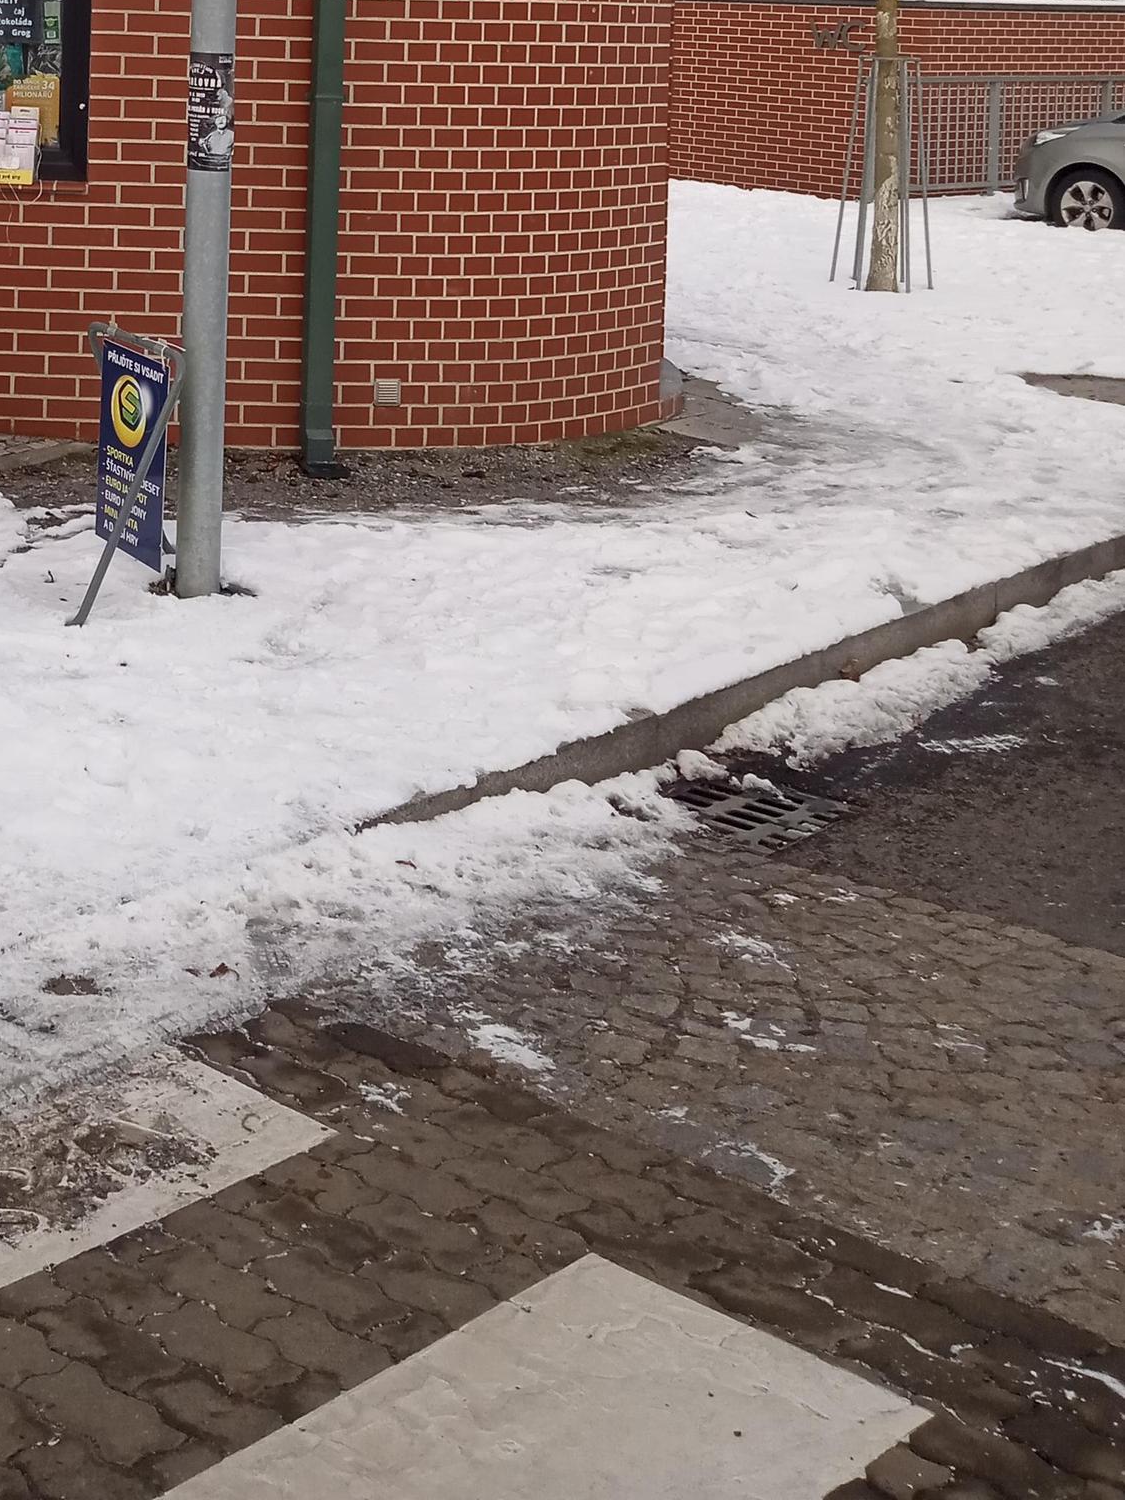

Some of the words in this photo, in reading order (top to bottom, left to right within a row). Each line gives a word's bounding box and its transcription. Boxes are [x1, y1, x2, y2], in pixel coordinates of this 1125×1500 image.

[12, 28, 32, 38] Grog
[809, 18, 867, 52] WC
[107, 350, 134, 371] PŘIJĎTE
[134, 362, 141, 374] SI
[141, 364, 164, 384] VSADIT
[106, 445, 134, 468] SPORTKA
[104, 489, 122, 506] EURO
[125, 530, 140, 547] HRY
